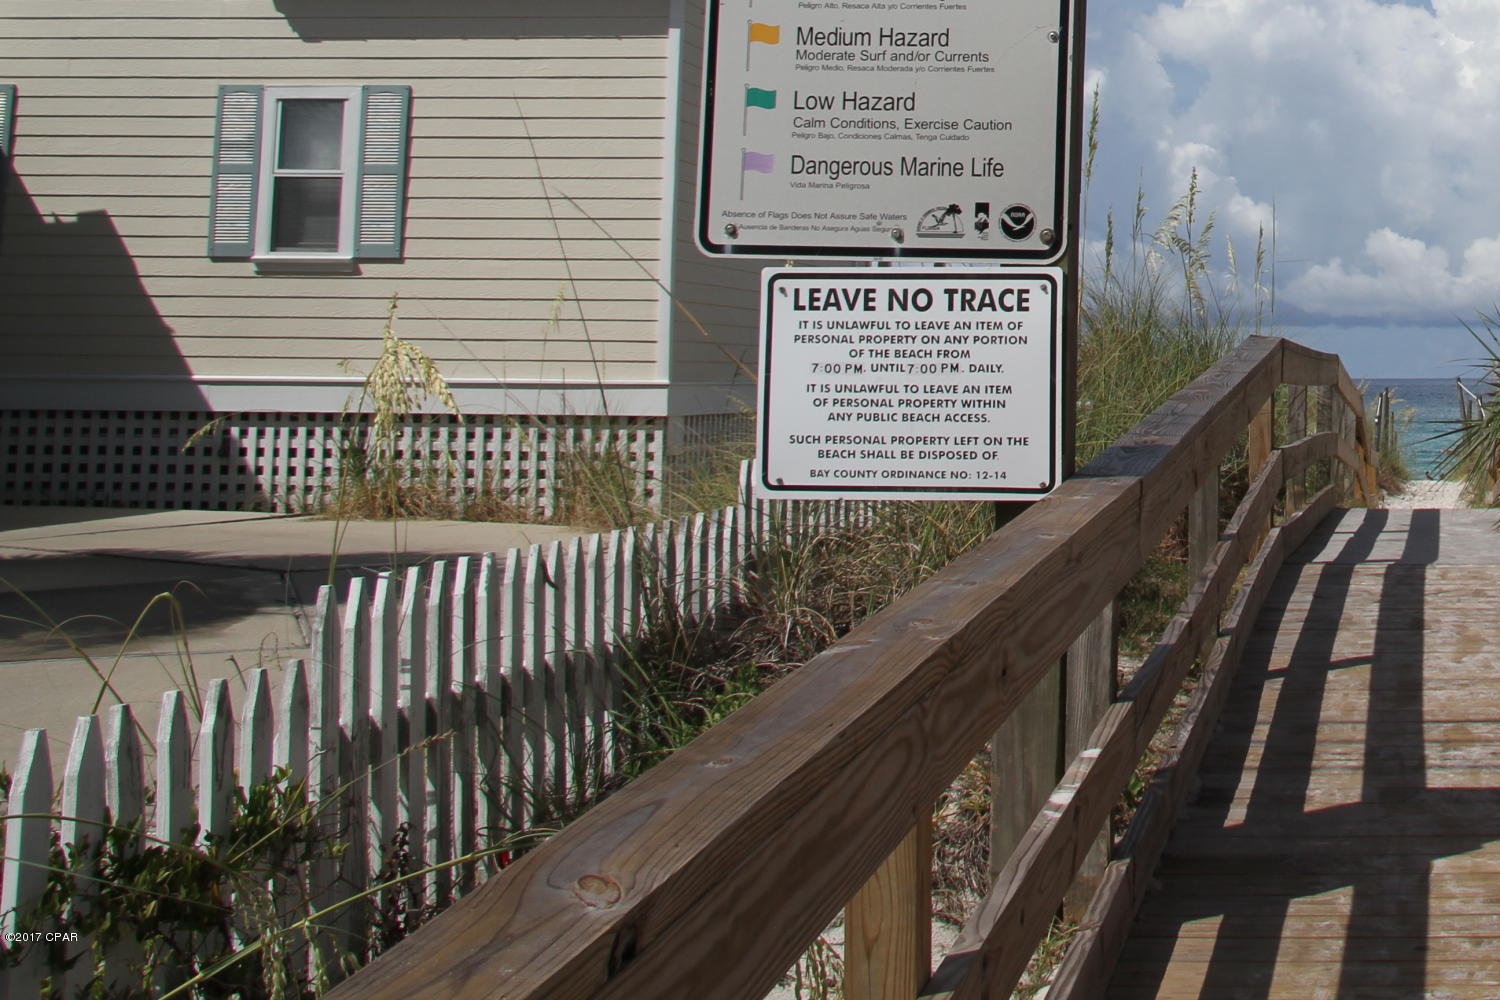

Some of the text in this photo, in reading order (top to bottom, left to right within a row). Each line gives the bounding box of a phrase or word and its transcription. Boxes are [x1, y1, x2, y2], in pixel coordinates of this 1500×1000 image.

[796, 26, 949, 47] Medium Hazard
[795, 49, 989, 62] Moderate Surf and/or Currents
[793, 90, 915, 111] Low Hazard
[792, 116, 1012, 130] Calm Conditions, Exercise Caution
[790, 155, 1004, 180] Dangerous Marine Life
[793, 288, 1030, 312] LEAVE NO TRACE
[798, 320, 1023, 330] IT IS UNLAWFUL TO LEAVE AN ITEM OF
[793, 334, 1027, 344] PERSONAL PROPERTY ON ANY PORTION
[848, 349, 970, 358] OF THE BEACH FROM
[806, 384, 1012, 394] IT IS UNLAWFUL TO LEAVE AN ITEM
[812, 398, 1006, 408] OF PERSONAL PROPERTY WITHIN
[827, 412, 990, 422] ANY PUBLIC BEACH ACCESS.
[789, 435, 1029, 445] SUCH PERSONAL PROPERTY LEFT ON THE
[817, 449, 856, 458] BEACH
[860, 449, 896, 458] SHALL
[900, 450, 914, 459] BE
[918, 450, 978, 459] DISPOSED
[809, 469, 1006, 479] BAY COUNTY ORDINANCE NO: 12-14
